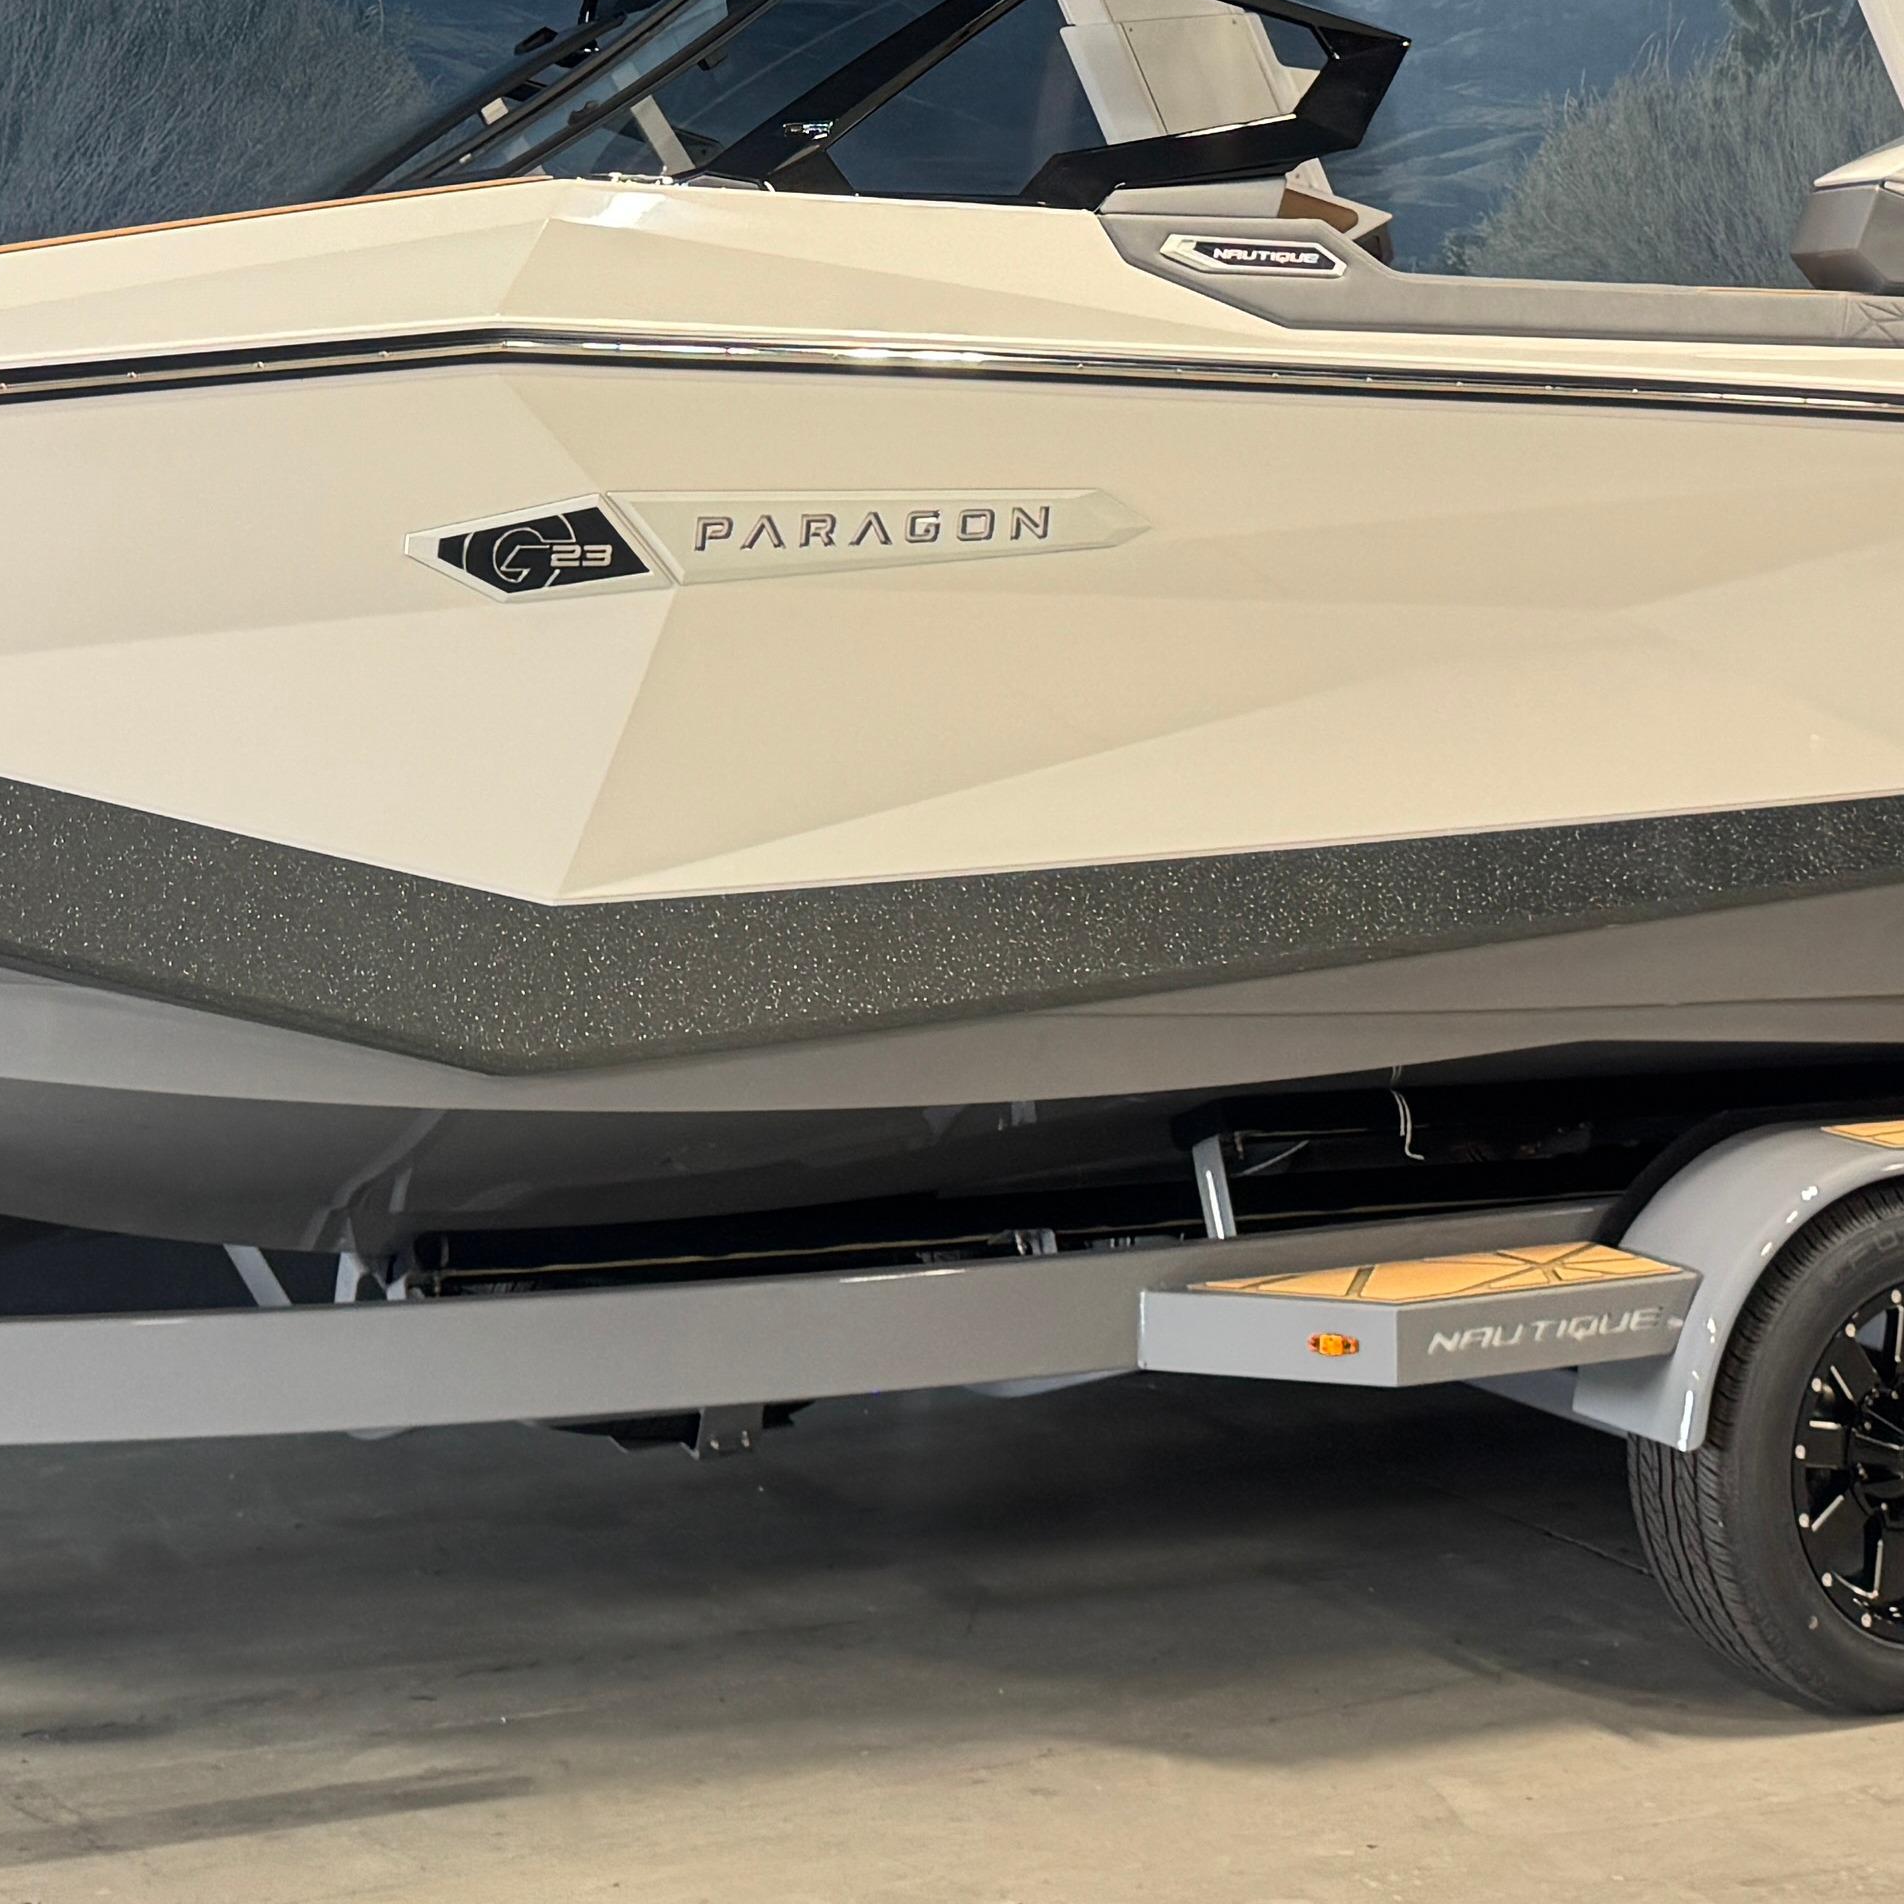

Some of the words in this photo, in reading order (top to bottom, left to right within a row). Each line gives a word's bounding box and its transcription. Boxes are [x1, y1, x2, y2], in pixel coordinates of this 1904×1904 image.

[1212, 247, 1321, 266] NAUTIQUE
[693, 504, 1052, 553] PARAGON
[1426, 1306, 1661, 1357] NAUTIQUE
